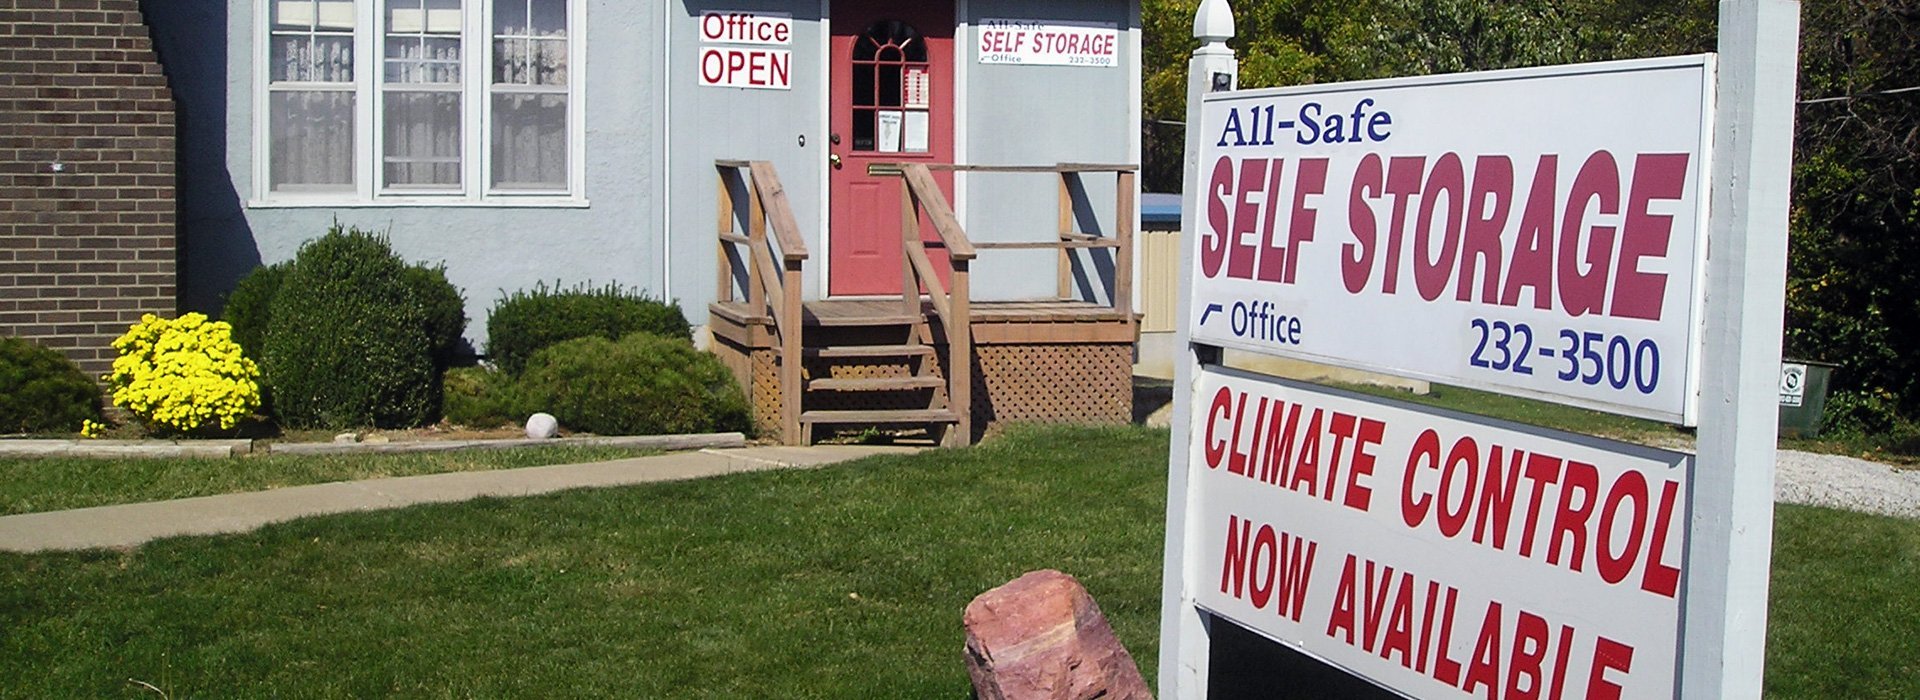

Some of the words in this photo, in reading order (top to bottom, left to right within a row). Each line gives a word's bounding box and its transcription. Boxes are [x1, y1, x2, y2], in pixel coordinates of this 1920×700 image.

[703, 12, 789, 42] Office
[982, 31, 1026, 53] SELF
[1032, 32, 1115, 55] STORAGE
[986, 20, 1044, 31] All-Safe
[702, 49, 789, 86] OPEN
[991, 54, 1022, 63] Office
[1069, 56, 1111, 65] 232-3500
[1217, 98, 1392, 147] All-Safe
[1201, 155, 1329, 285] SELF
[1341, 149, 1690, 322] STORAGE
[1231, 300, 1302, 345] Office
[1469, 318, 1660, 394] 232-3500
[1204, 385, 1386, 512] CLIMATE
[1400, 428, 1680, 598] CONTROL
[1220, 514, 1317, 622] NOW
